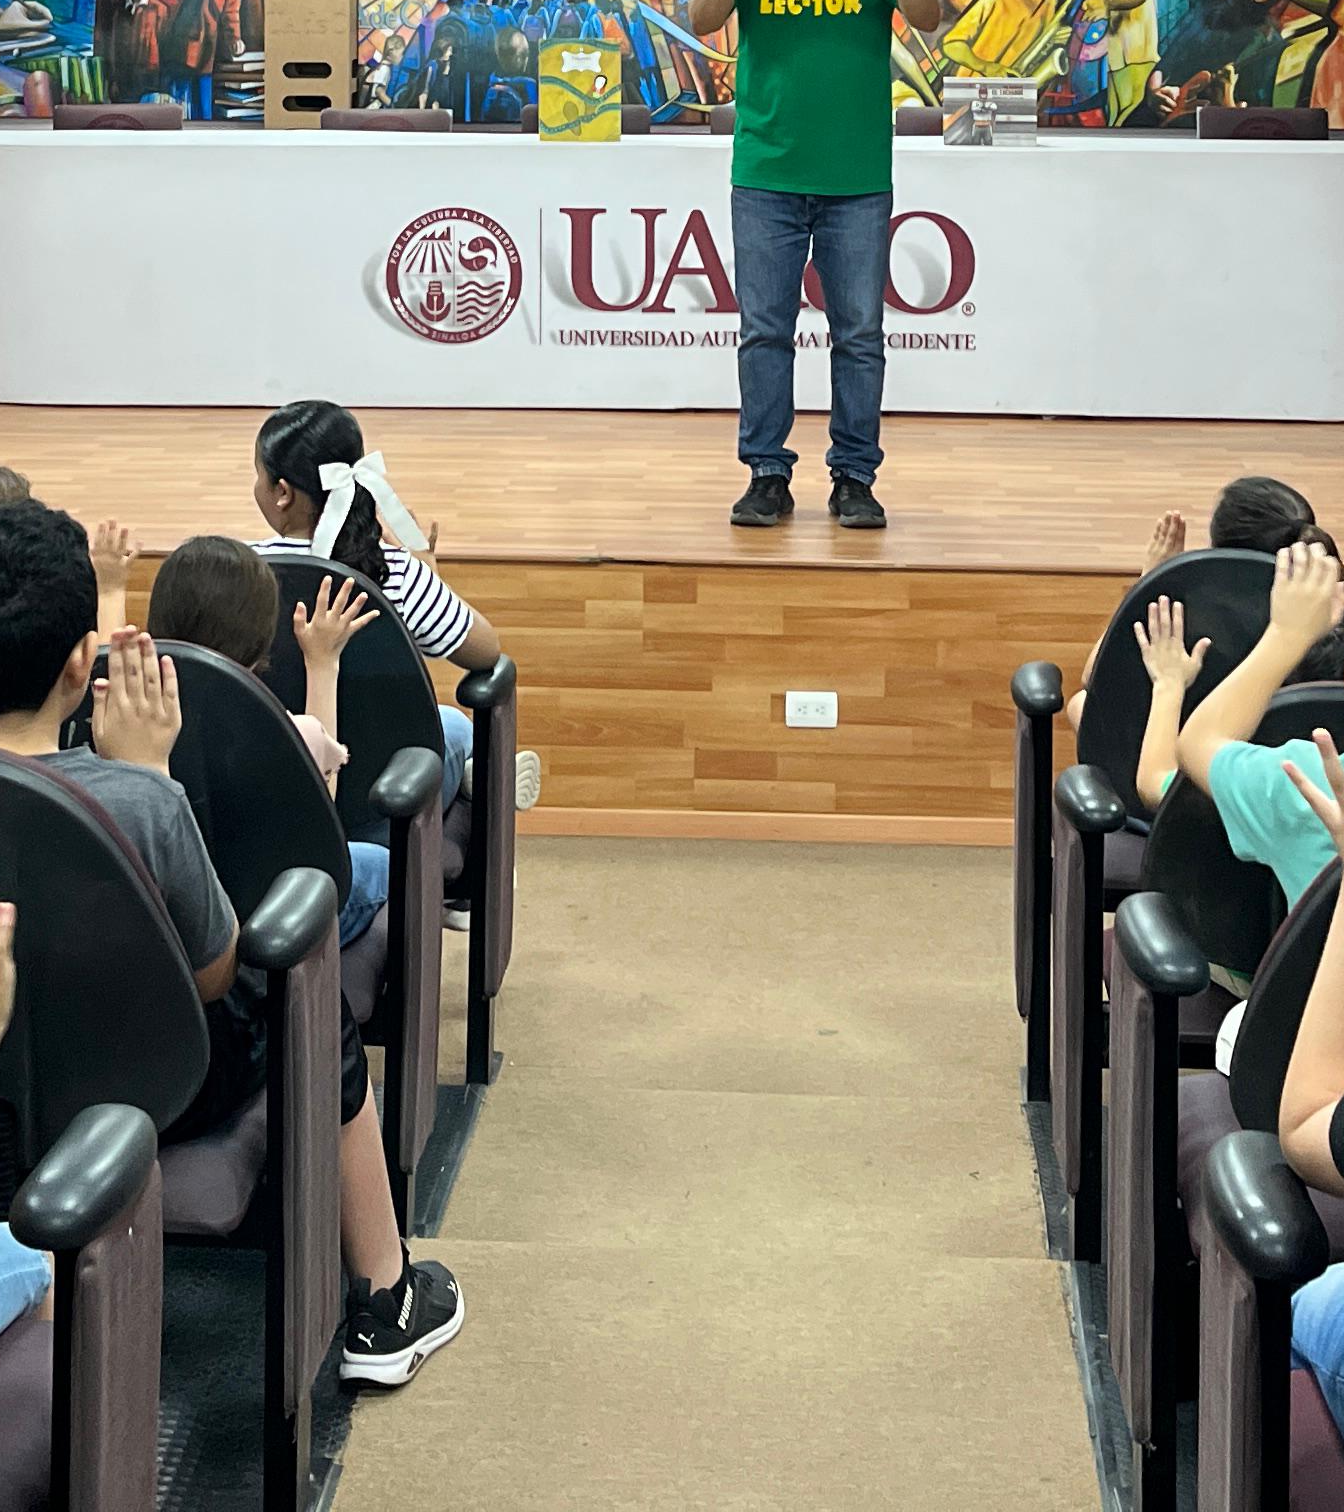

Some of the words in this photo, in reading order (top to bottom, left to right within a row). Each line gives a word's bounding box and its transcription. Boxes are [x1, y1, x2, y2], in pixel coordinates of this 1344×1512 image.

[559, 208, 975, 315] UAO
[559, 330, 695, 348] UNIVERSIDAD
[700, 330, 819, 348] AUTMA
[884, 333, 976, 350] CIDENTE
[397, 1283, 413, 1330] PUMA
